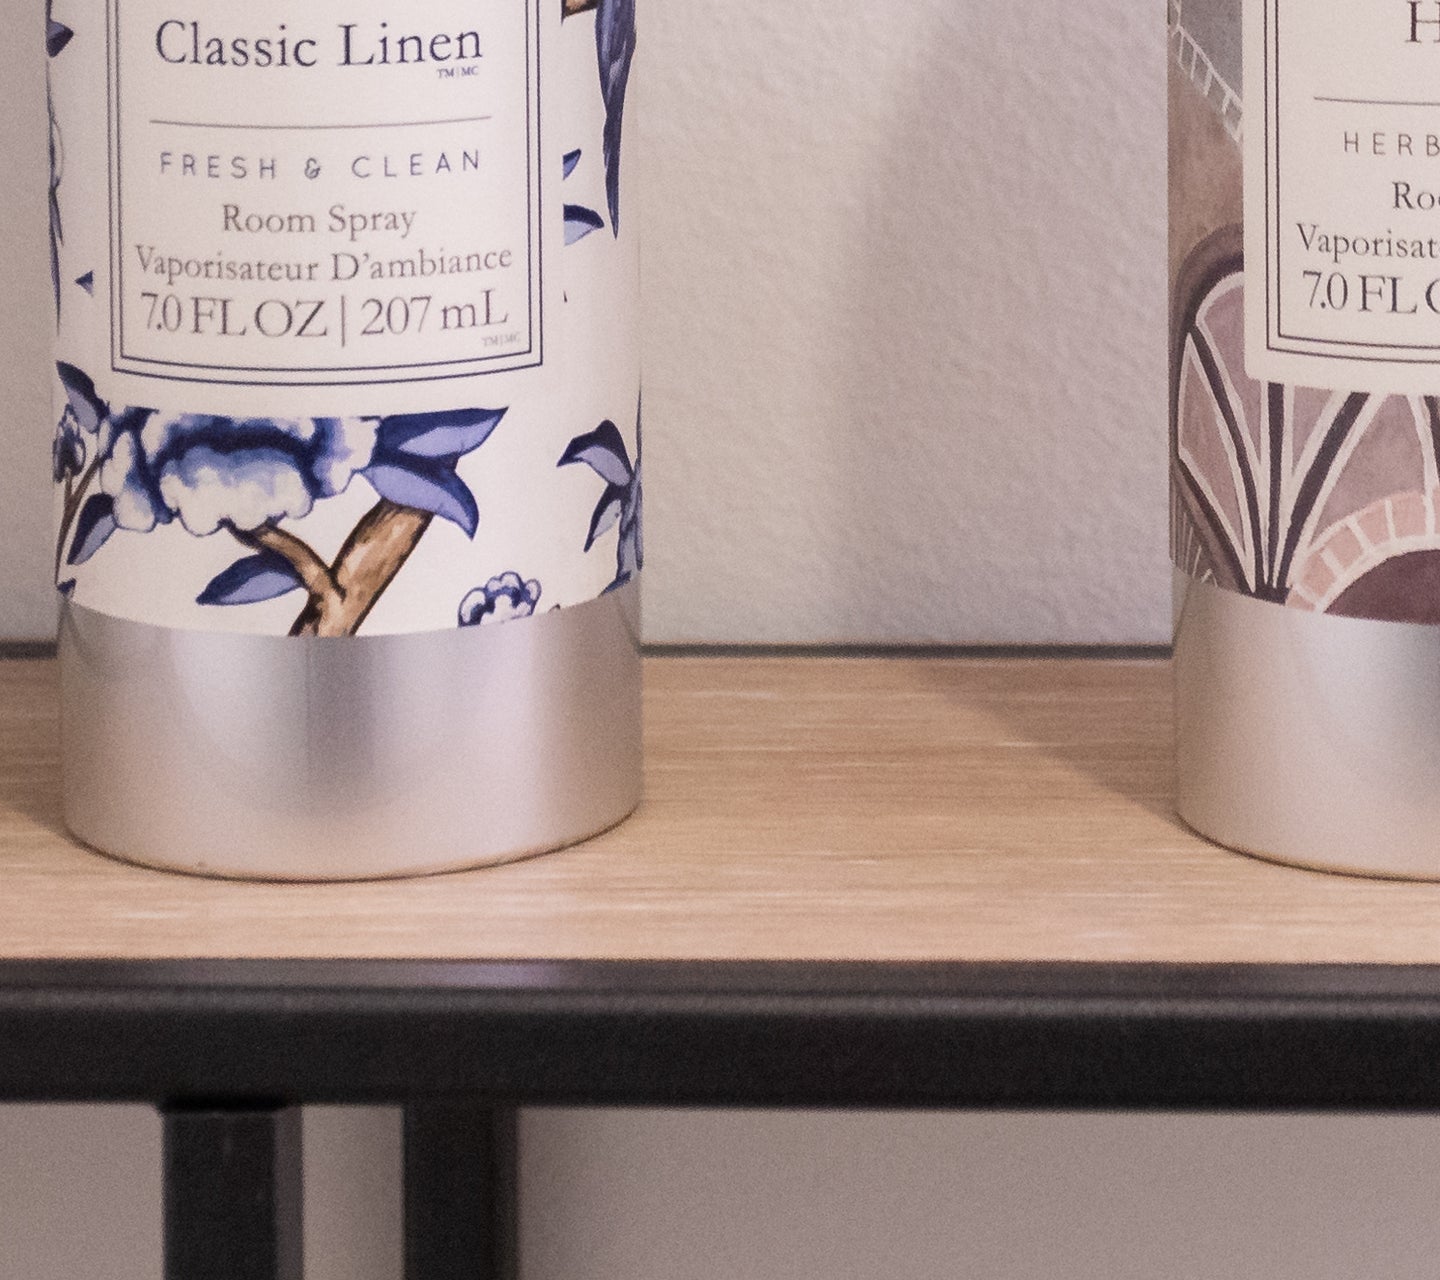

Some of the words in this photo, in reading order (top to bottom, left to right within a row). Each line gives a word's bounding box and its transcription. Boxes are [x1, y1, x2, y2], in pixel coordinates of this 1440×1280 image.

[155, 19, 317, 68] Classic
[338, 21, 483, 66] Linen
[159, 150, 276, 180] FRESH
[303, 156, 322, 181] &
[350, 149, 480, 179] CLEAN
[222, 203, 316, 233] Room
[328, 203, 416, 242] Spray
[132, 242, 319, 287] Vaporisateur
[330, 248, 512, 282] D'ambiance
[140, 291, 183, 331] 7.0
[190, 296, 247, 337] FL
[253, 300, 328, 337] OZ
[360, 295, 432, 336] 207
[441, 289, 509, 330] mL
[1302, 269, 1349, 309] 7.0
[1358, 274, 1418, 314] FL
